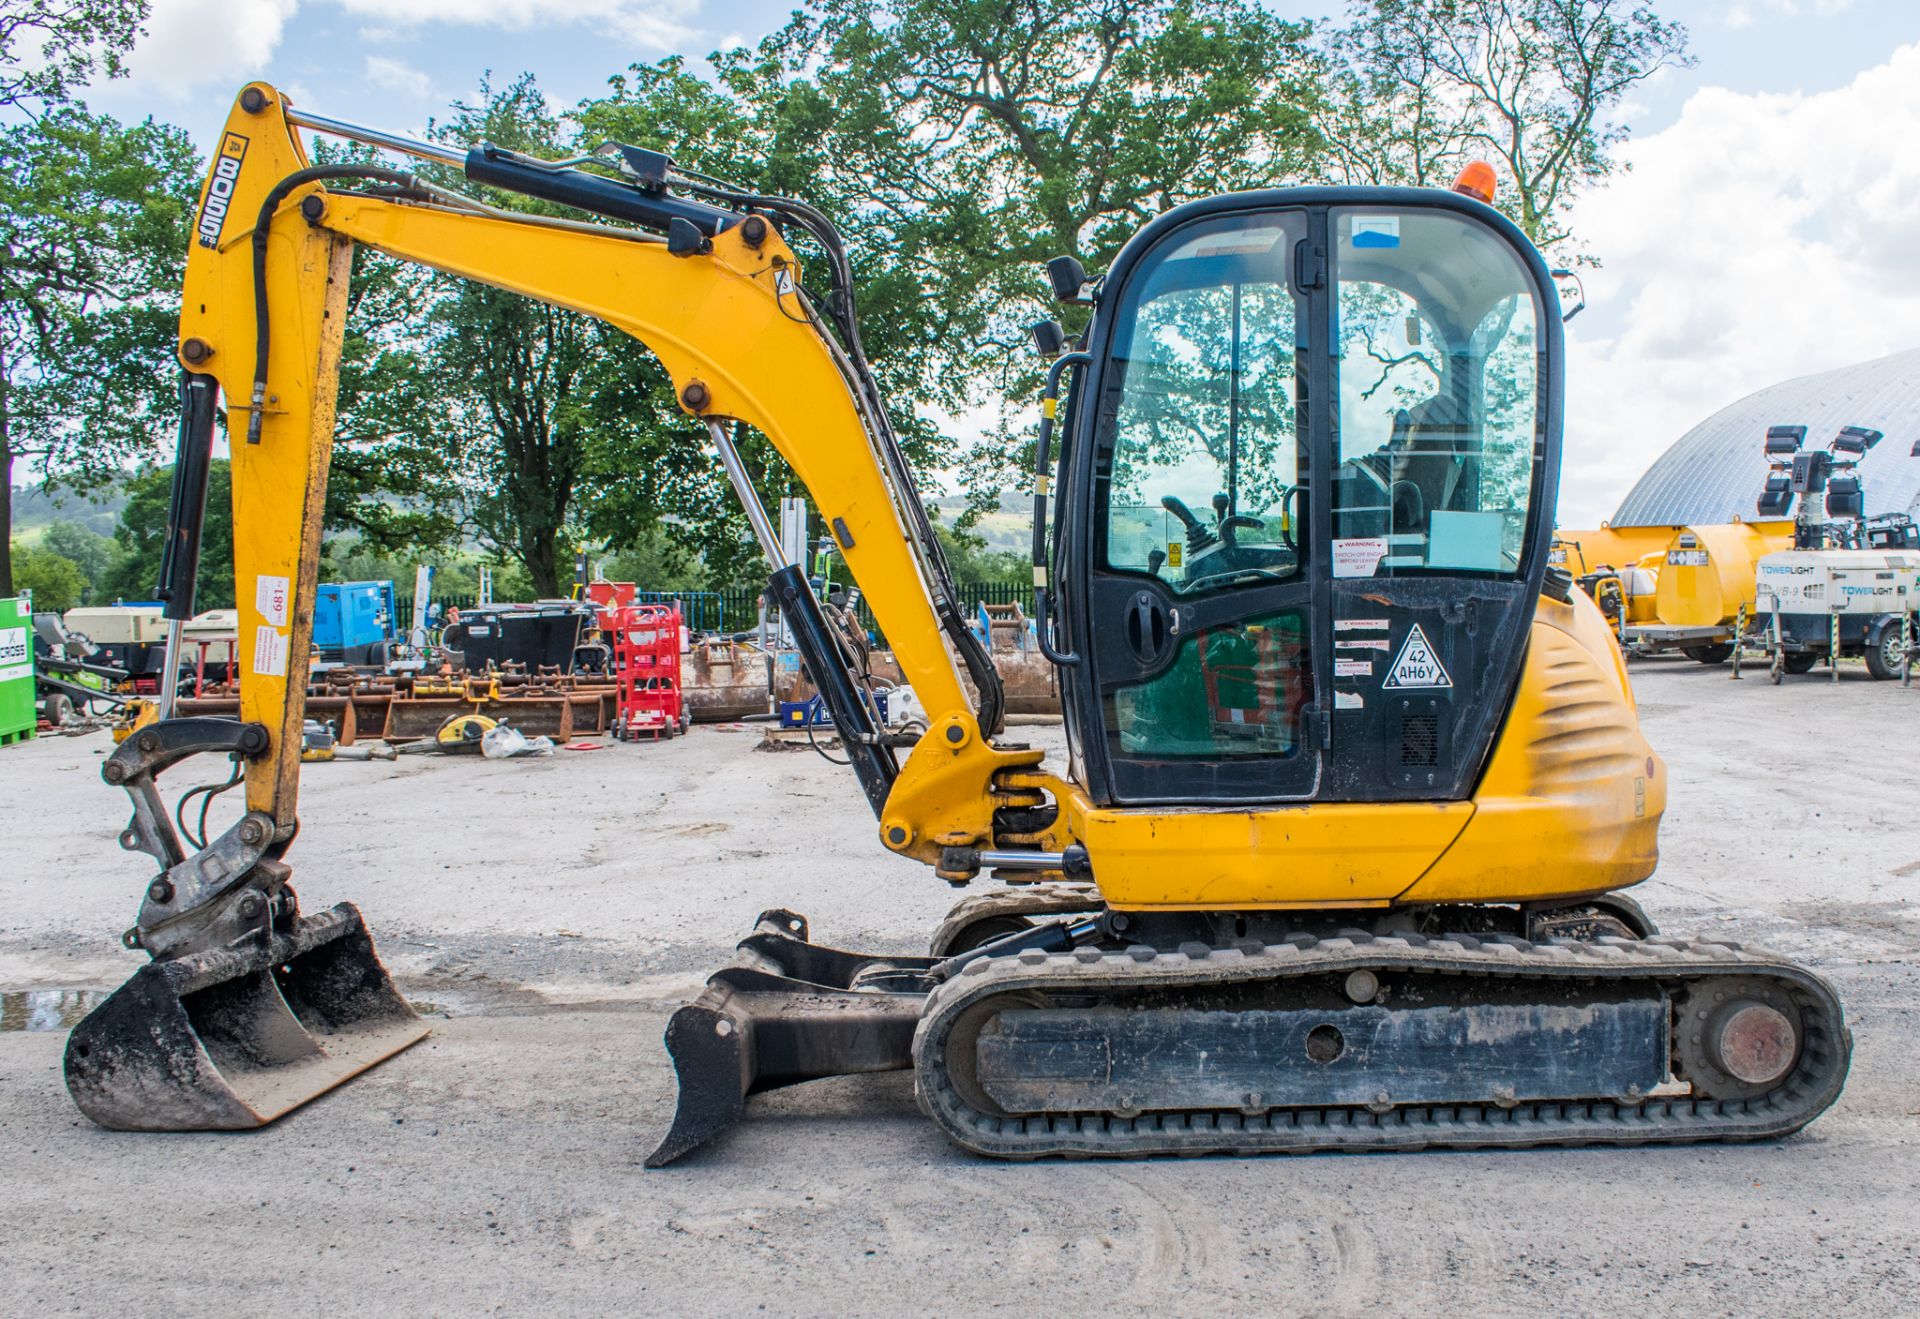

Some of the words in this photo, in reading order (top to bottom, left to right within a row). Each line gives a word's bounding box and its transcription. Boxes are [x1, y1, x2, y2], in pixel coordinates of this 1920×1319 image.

[199, 157, 240, 236] 8055
[1761, 566, 1815, 575] TOWERLIGHT
[1841, 586, 1893, 596] TOWERLIGHT
[272, 589, 284, 612] 681
[1409, 650, 1426, 663] 42
[1399, 665, 1435, 680] AH6Y
